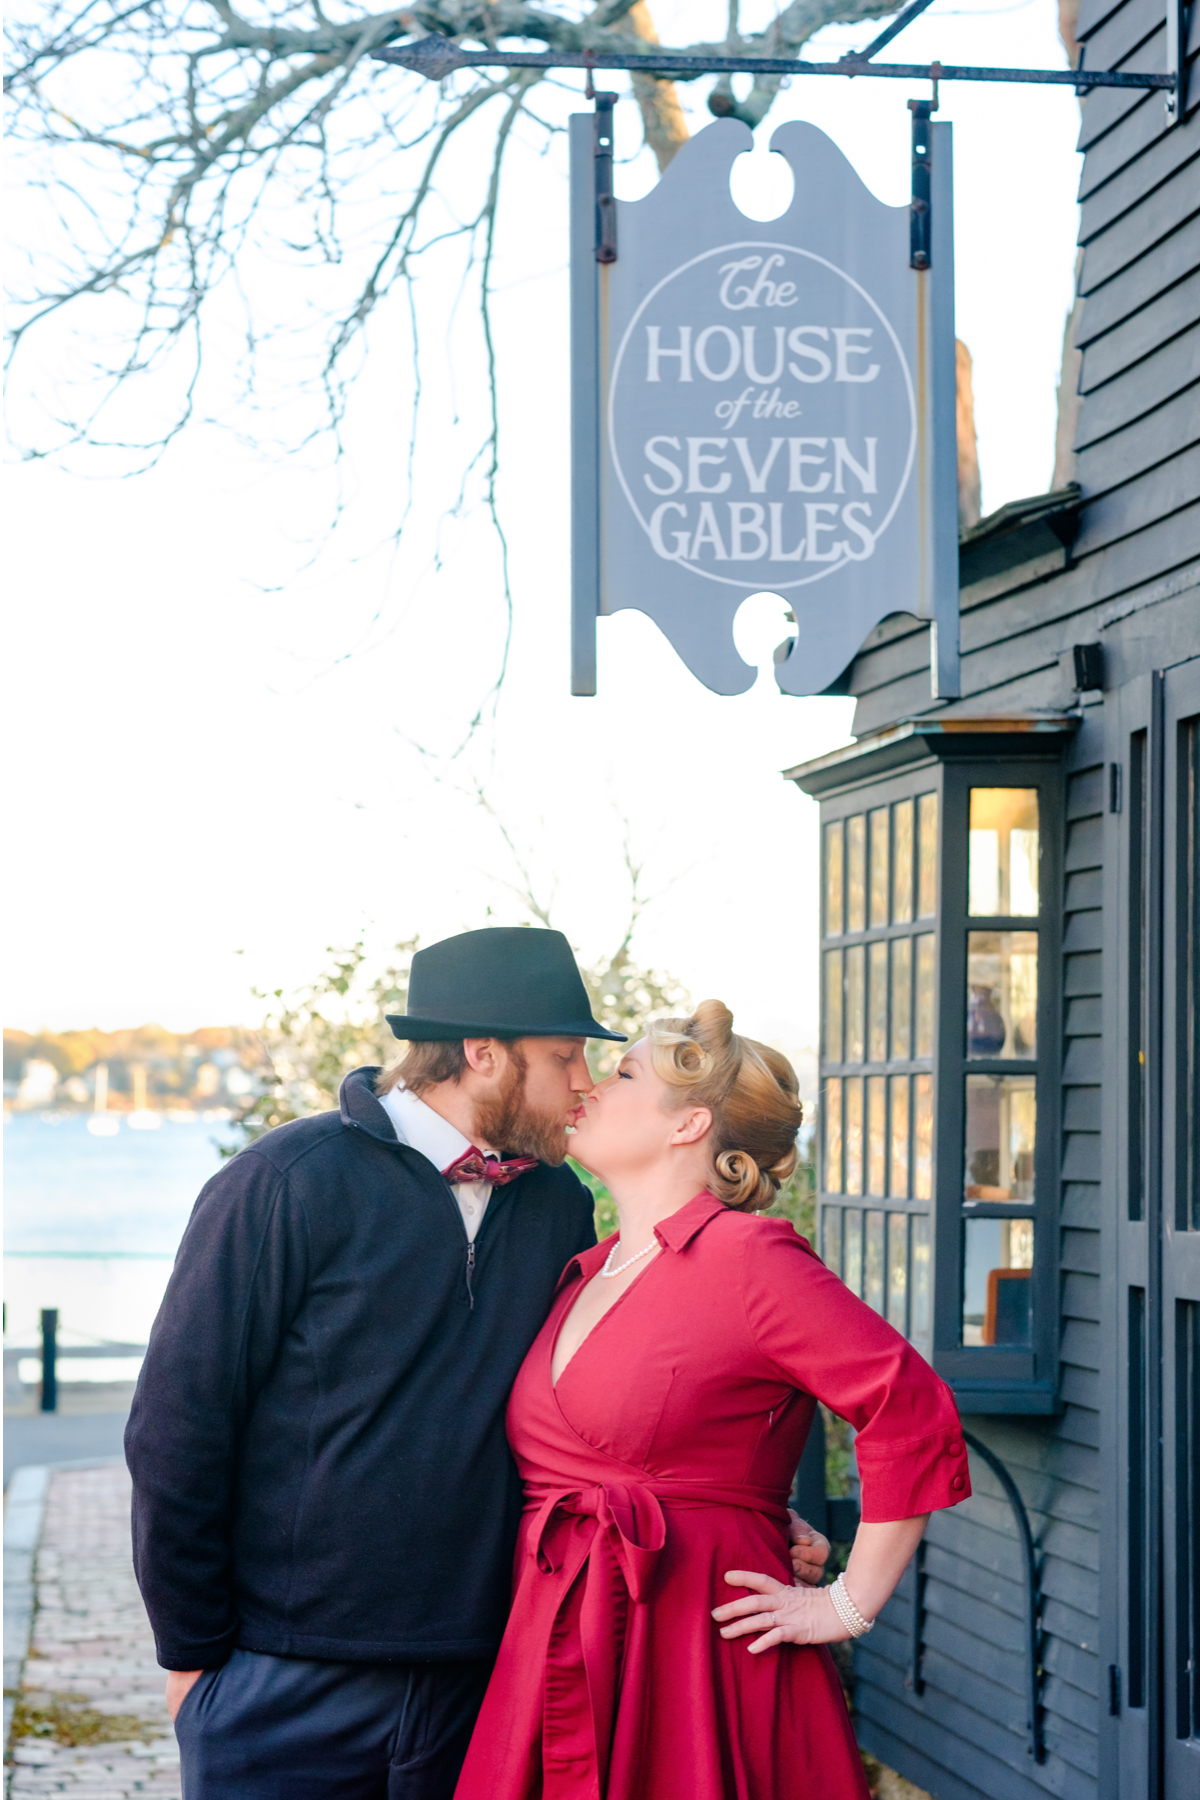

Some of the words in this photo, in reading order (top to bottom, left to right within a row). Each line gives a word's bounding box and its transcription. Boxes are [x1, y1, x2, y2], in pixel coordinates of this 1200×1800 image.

[718, 254, 799, 310] The
[645, 325, 881, 384] HOUSE
[715, 386, 755, 430] of
[753, 388, 802, 419] the
[643, 435, 879, 496] SEVEN
[650, 501, 879, 562] GABLES
